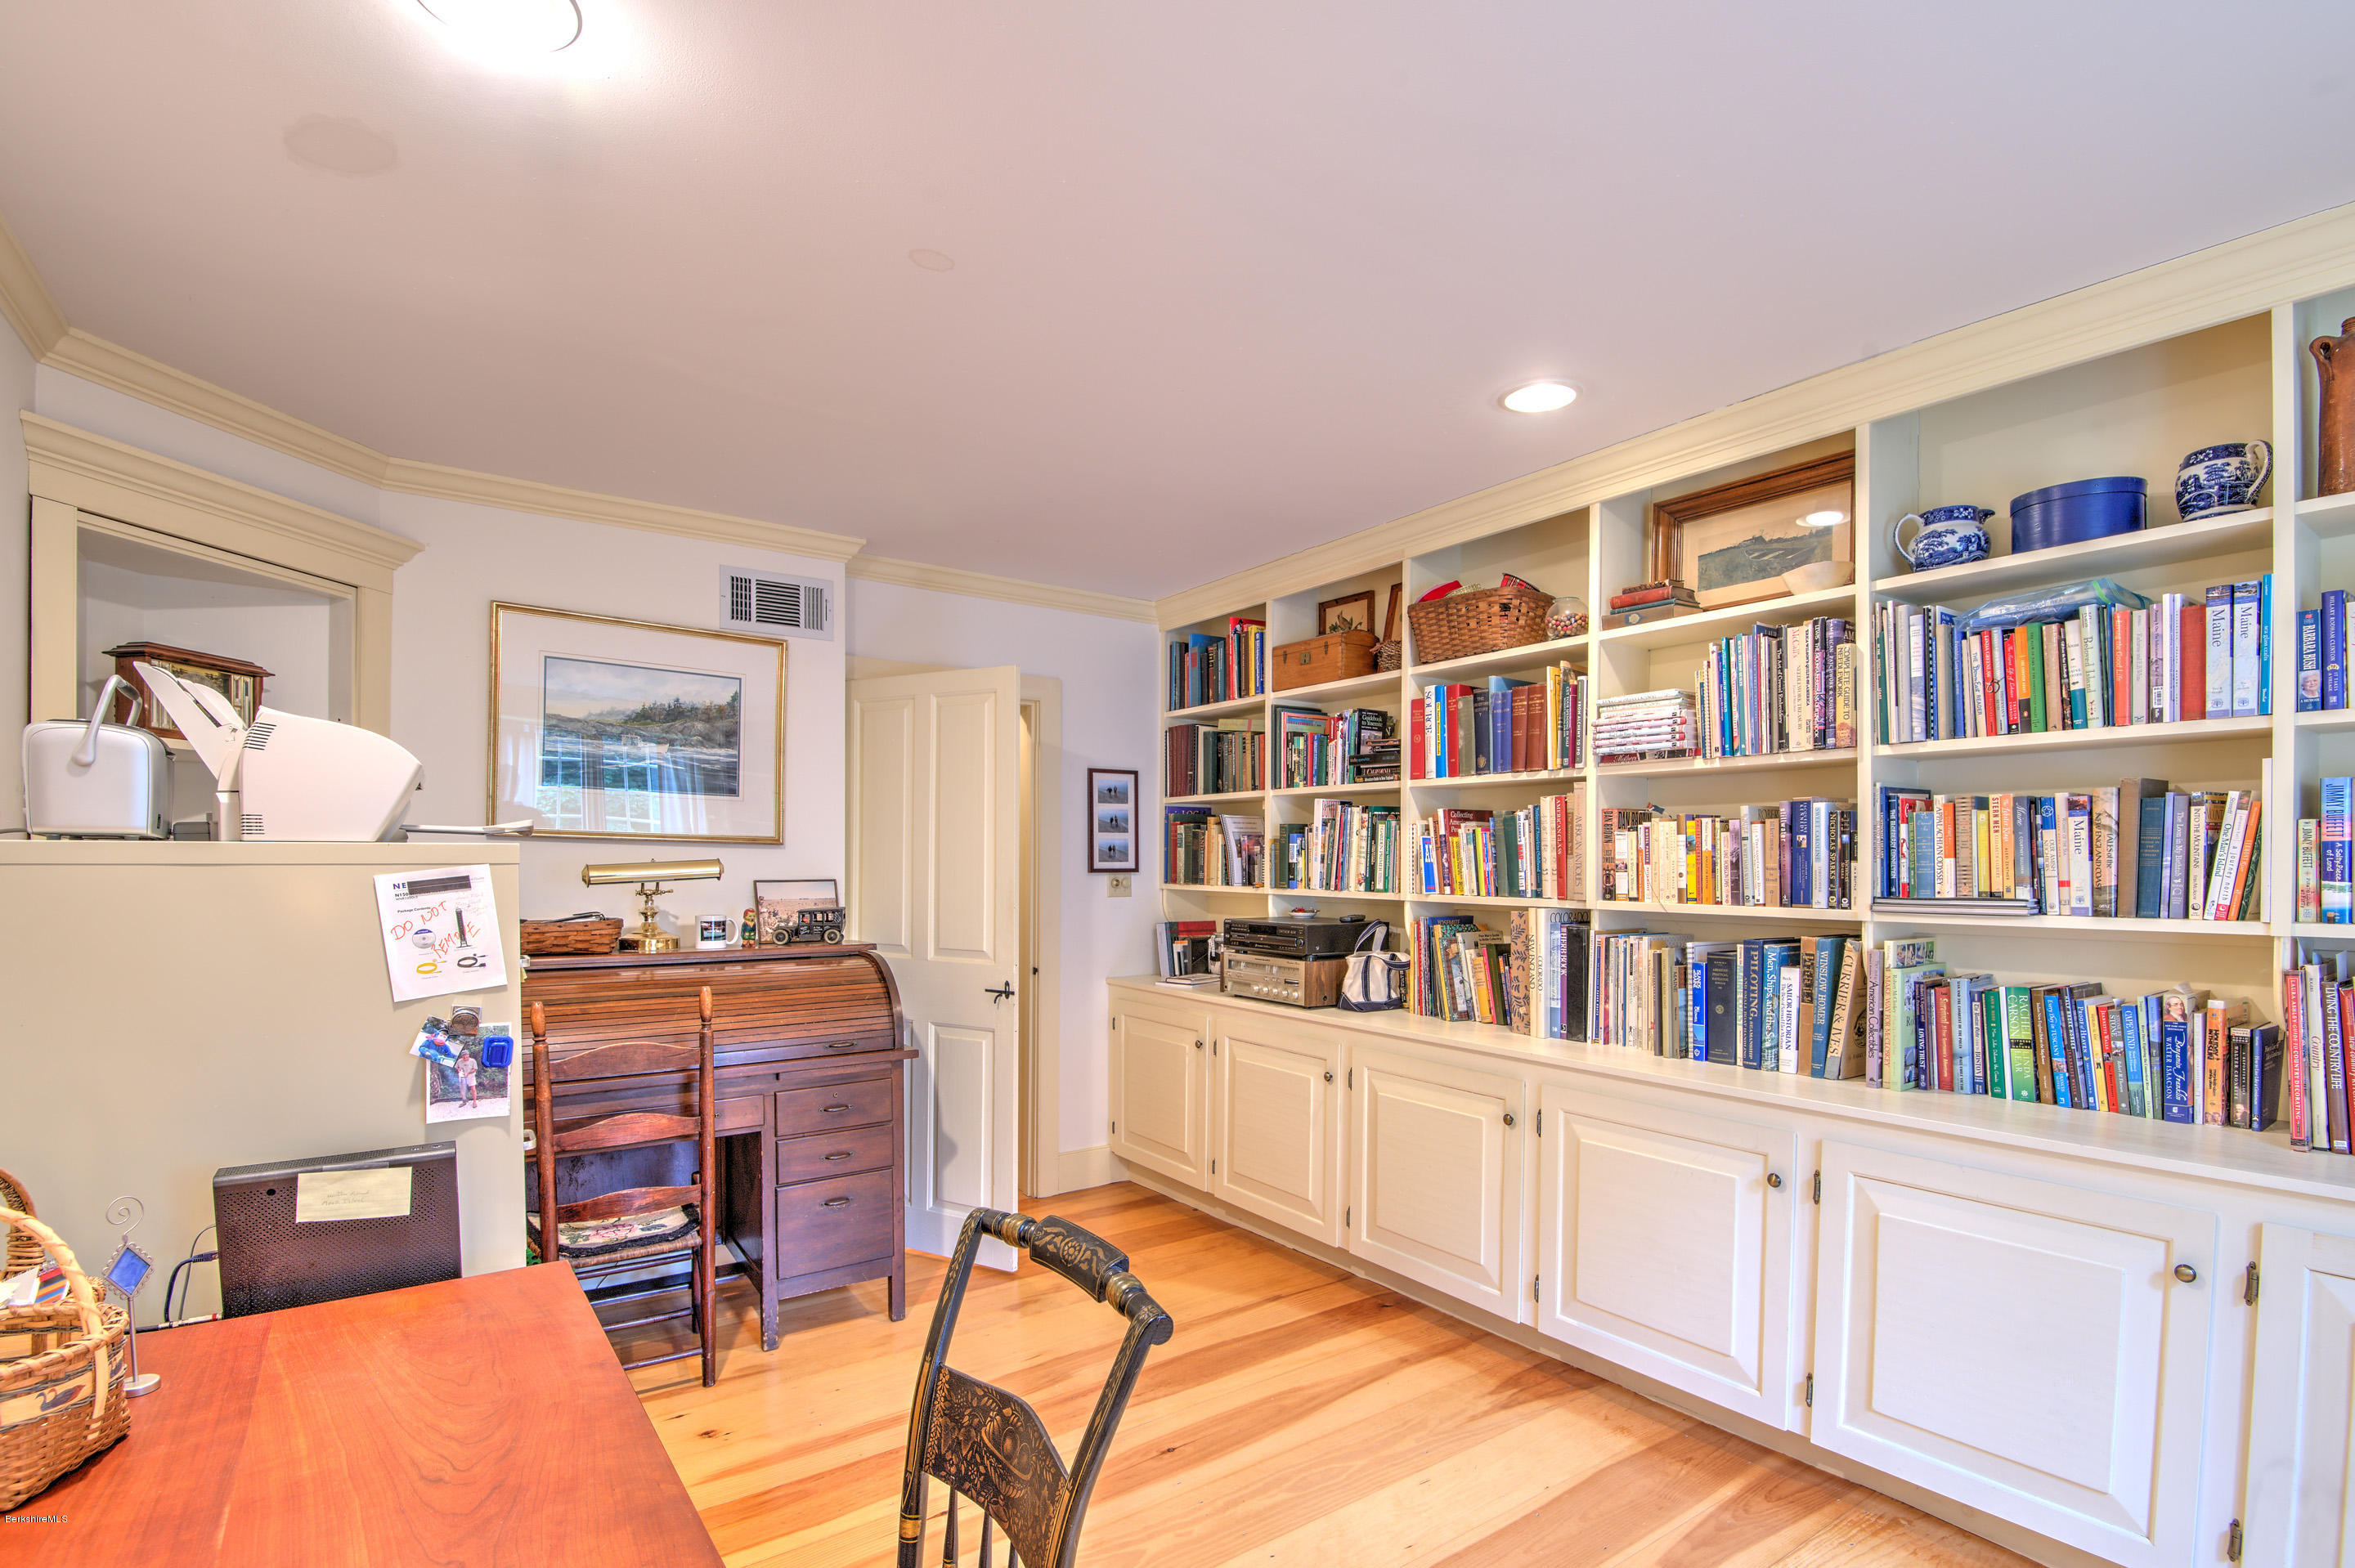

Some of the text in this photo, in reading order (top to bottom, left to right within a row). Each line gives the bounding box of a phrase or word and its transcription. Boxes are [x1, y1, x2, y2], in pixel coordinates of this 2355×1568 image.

[2212, 609, 2225, 647] Maine
[2240, 606, 2252, 639] Maine
[1792, 628, 1800, 658] McCall's
[2303, 625, 2316, 670] BARBARA BUSH
[2083, 637, 2096, 693] Beloved Island
[1844, 710, 1850, 720] TO
[1604, 811, 1613, 843] DAN BROWN
[2016, 803, 2026, 827] Maine
[2326, 784, 2344, 838] JIMMY BUFFETT
[2074, 820, 2084, 854] Maine
[2175, 845, 2182, 854] My
[2215, 823, 2232, 877] One Man's Island
[2302, 827, 2313, 868] JIMMY BUFFETT
[2225, 852, 2237, 879] journey
[2335, 849, 2344, 863] Salty
[390, 920, 413, 941] DO
[421, 900, 447, 925] NOT
[1550, 912, 1589, 923] COLORADO
[1766, 952, 1776, 973] Men,
[1748, 950, 1758, 1020] PILOTING,
[1765, 975, 1775, 998] Ships,
[1817, 950, 1828, 1025] WINSLOW HOMER
[1766, 999, 1775, 1015] and
[1829, 955, 1854, 1055] CURRIER & IVES
[1868, 981, 1878, 1058] American Collectibles
[1939, 998, 1949, 1024] Survival
[2008, 995, 2018, 1038] CARSON
[2019, 995, 2030, 1038] RACHEL
[1766, 1016, 1775, 1031] the
[2125, 1010, 2135, 1049] CAPE WIND
[2326, 987, 2342, 1089] LIVING THE COUNTRY LIFE
[2170, 1032, 2187, 1100] Benjamin Franklin
[2311, 1036, 2322, 1071] Country
